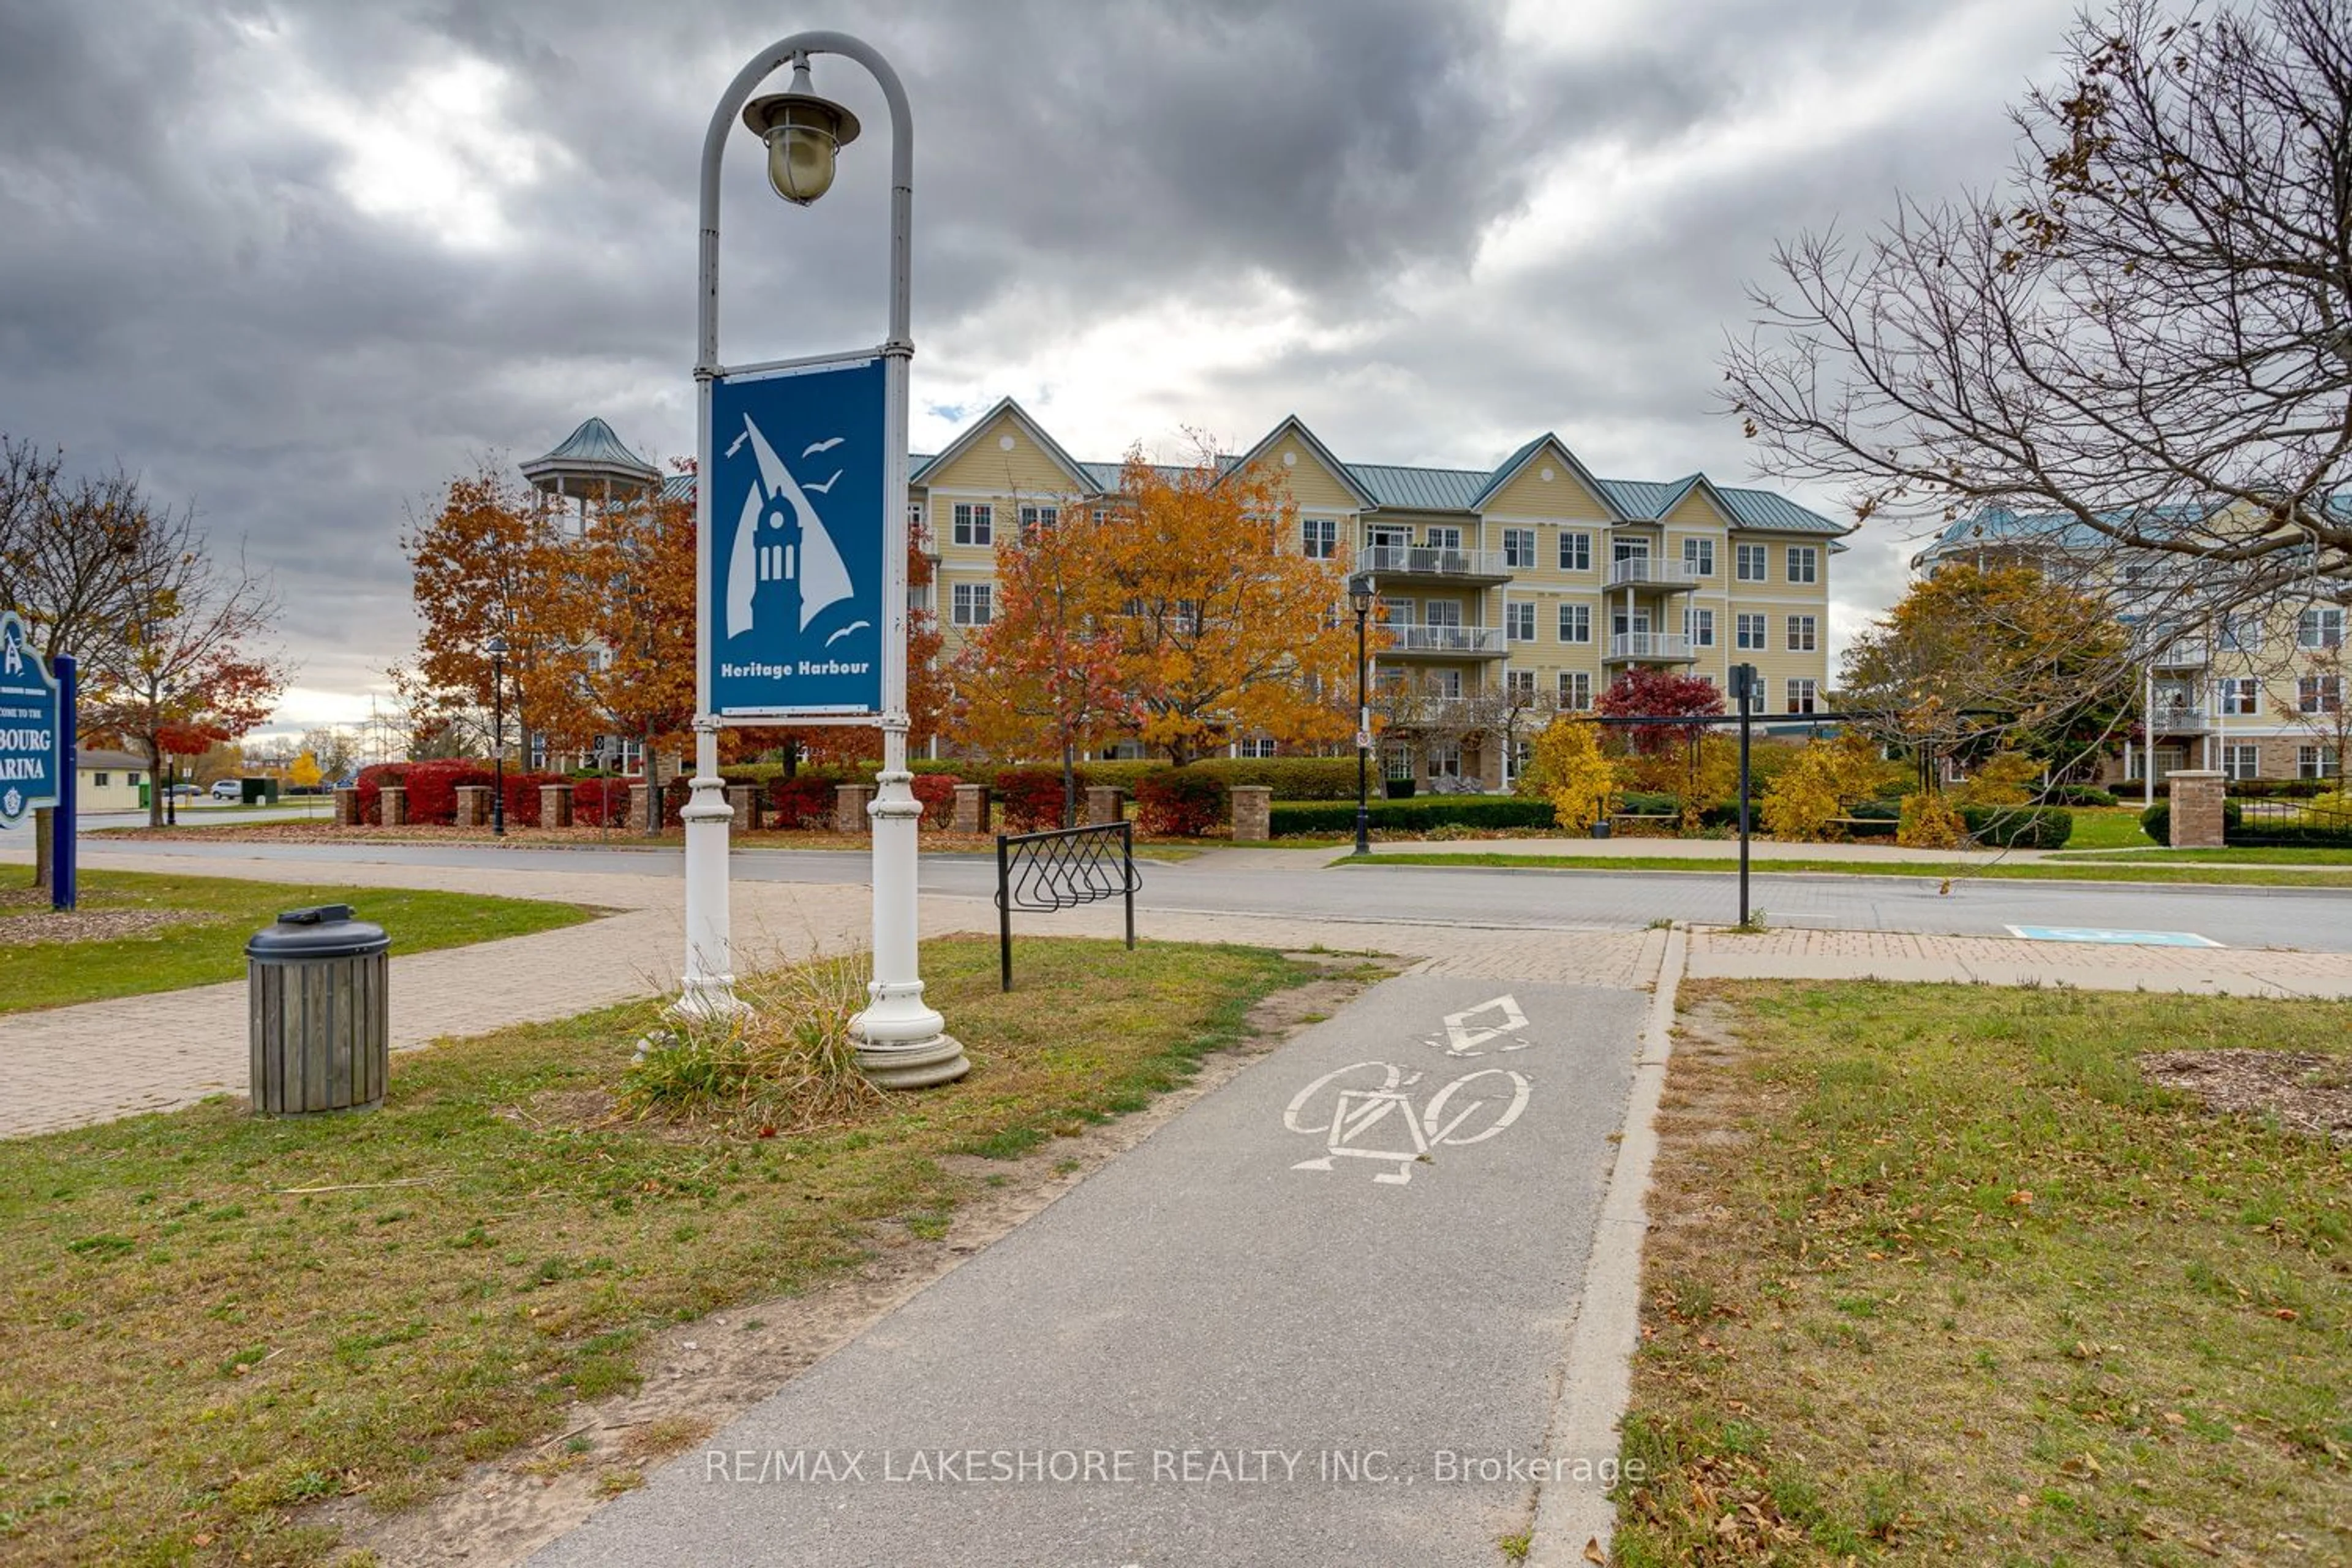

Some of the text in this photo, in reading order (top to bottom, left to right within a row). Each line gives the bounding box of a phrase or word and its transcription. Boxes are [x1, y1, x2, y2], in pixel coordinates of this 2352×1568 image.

[721, 660, 869, 679] Heritage Harbour
[18, 709, 28, 718] TO
[28, 709, 42, 719] THE
